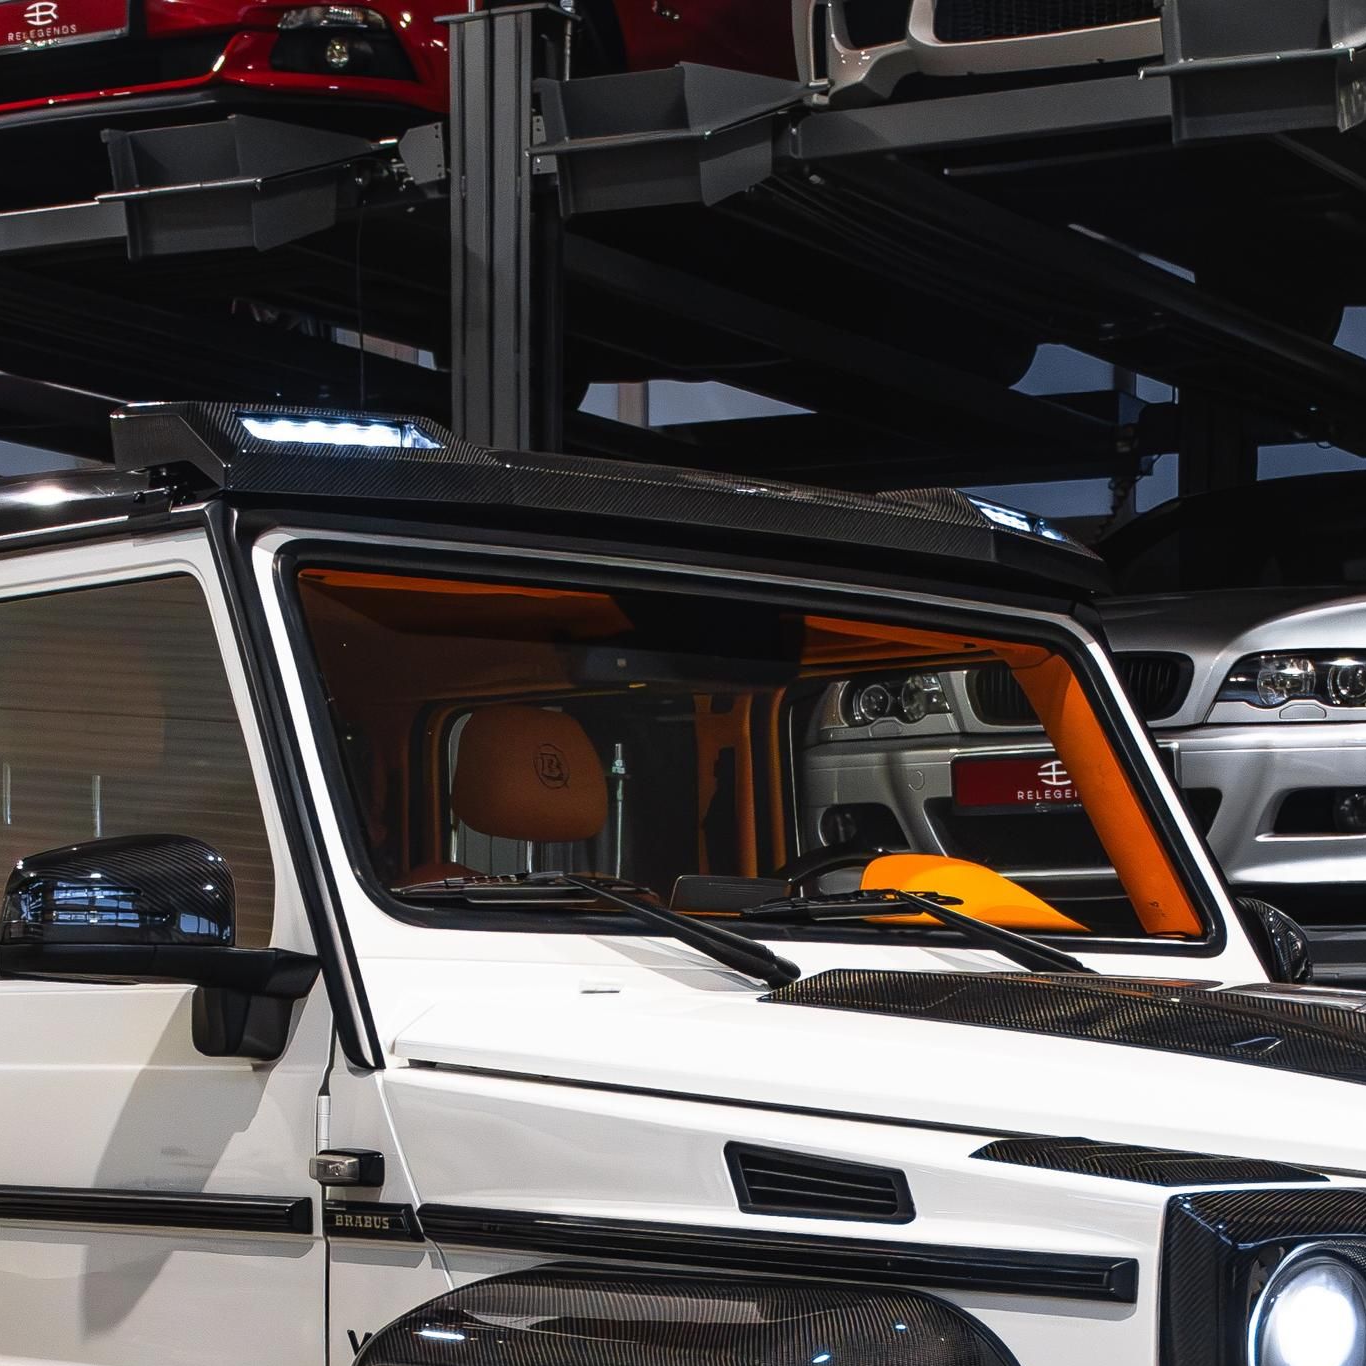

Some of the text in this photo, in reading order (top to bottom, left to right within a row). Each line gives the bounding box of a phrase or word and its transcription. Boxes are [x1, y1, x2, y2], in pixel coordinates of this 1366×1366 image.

[8, 24, 77, 42] RELEGENDS
[1017, 789, 1078, 800] RELEGE
[335, 1214, 390, 1230] BRABUS
